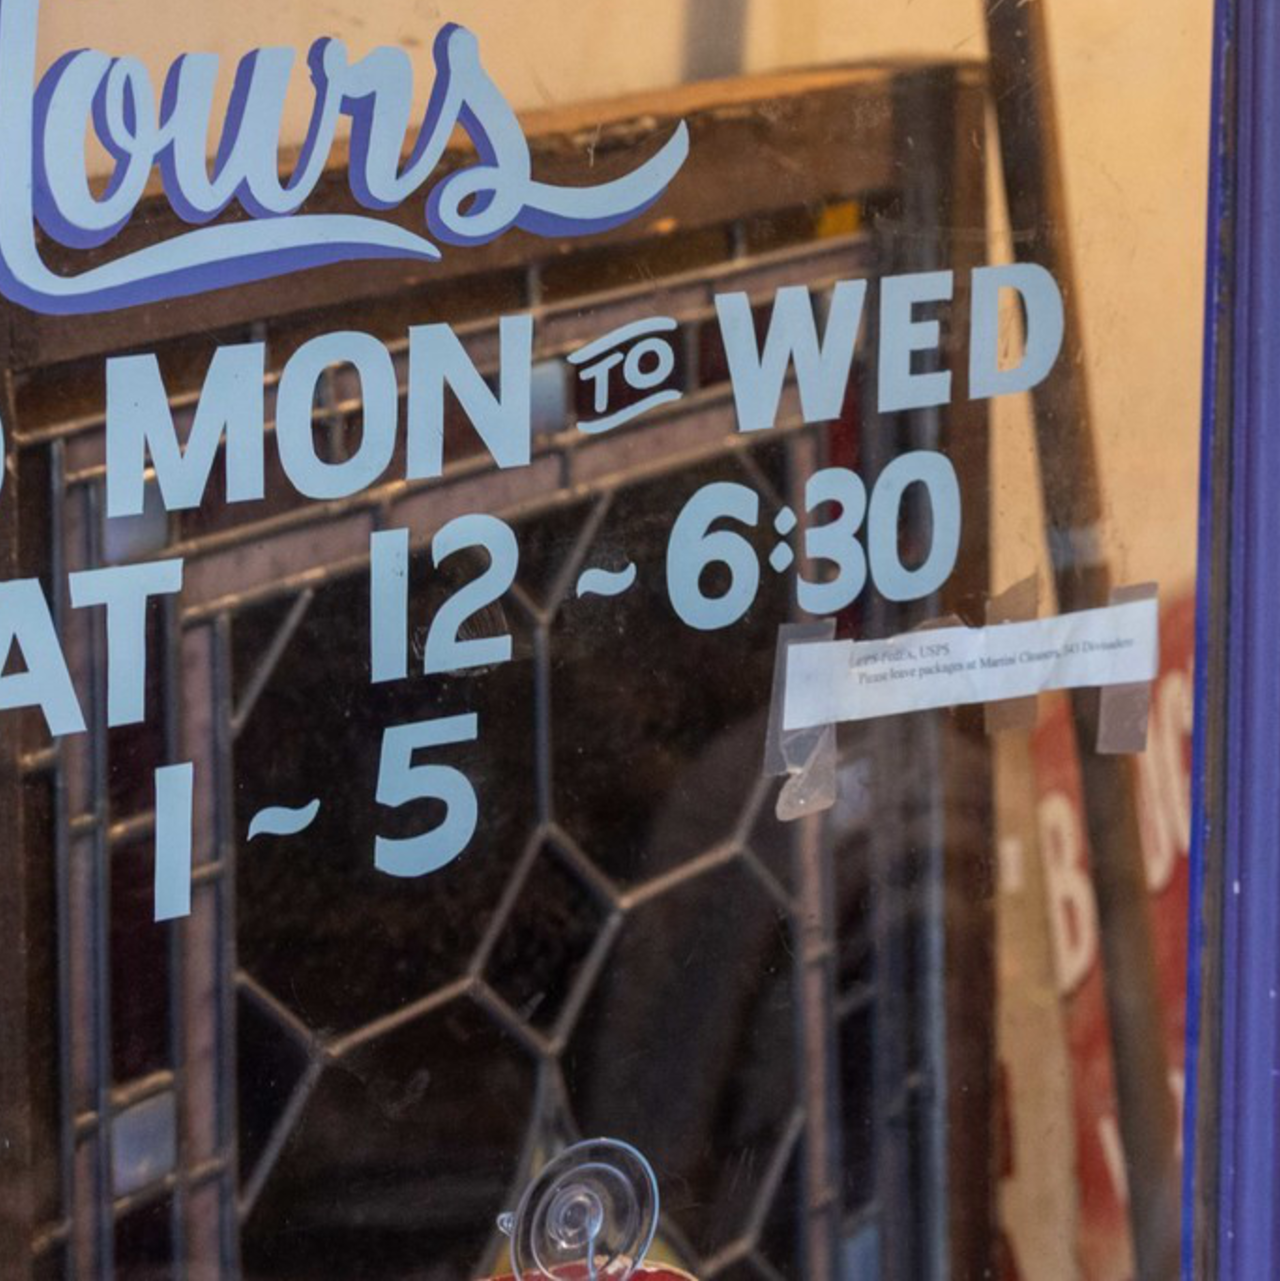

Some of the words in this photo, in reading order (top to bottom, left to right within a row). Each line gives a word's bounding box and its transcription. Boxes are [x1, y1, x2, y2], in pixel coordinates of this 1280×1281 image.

[105, 314, 534, 518] MON
[577, 332, 678, 416] TO
[714, 261, 1066, 433] WED
[369, 513, 520, 684] 12
[664, 449, 962, 631] 6:30
[858, 671, 888, 686] Please
[890, 667, 916, 680] leave
[918, 659, 964, 680] packages
[153, 761, 195, 923] 1
[373, 711, 479, 878] 5
